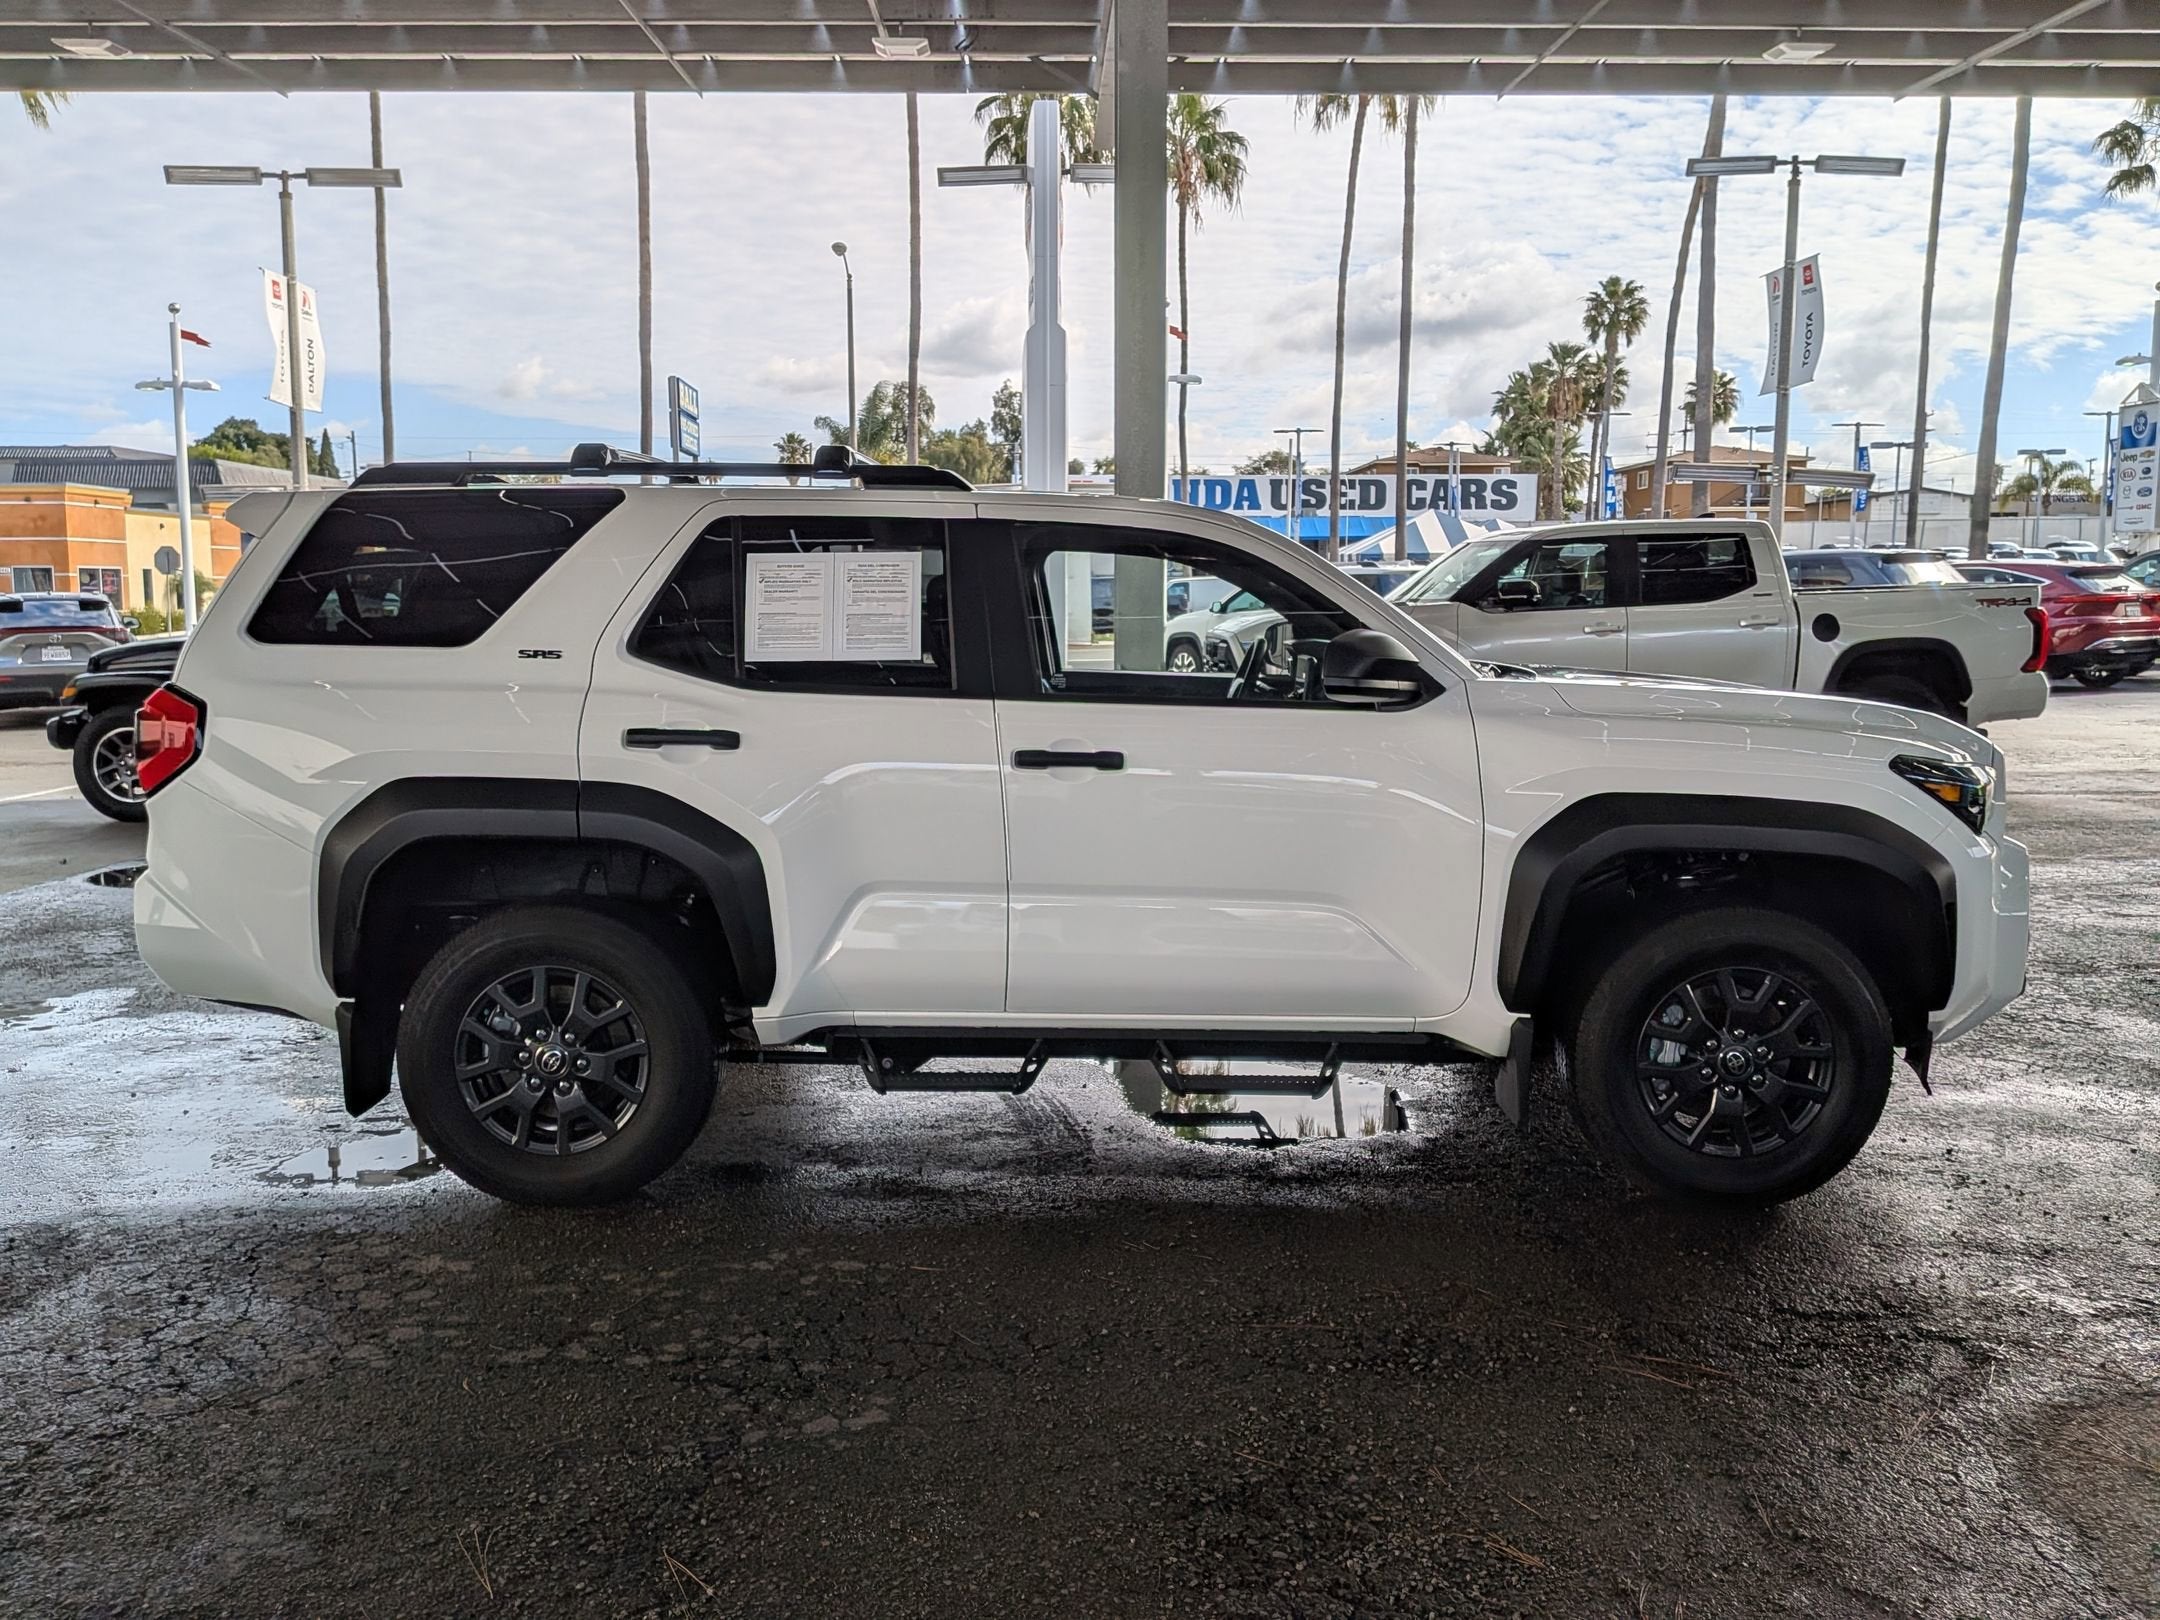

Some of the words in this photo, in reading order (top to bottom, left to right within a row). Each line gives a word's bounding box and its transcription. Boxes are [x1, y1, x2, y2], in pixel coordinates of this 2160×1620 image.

[1801, 311, 1815, 369] TOYOTA
[306, 338, 315, 394] DALTON
[2120, 453, 2138, 464] Jeep
[1269, 478, 1387, 511] USED
[1406, 478, 1518, 511] CARS
[2135, 503, 2152, 511] GMC
[517, 649, 563, 660] SR5
